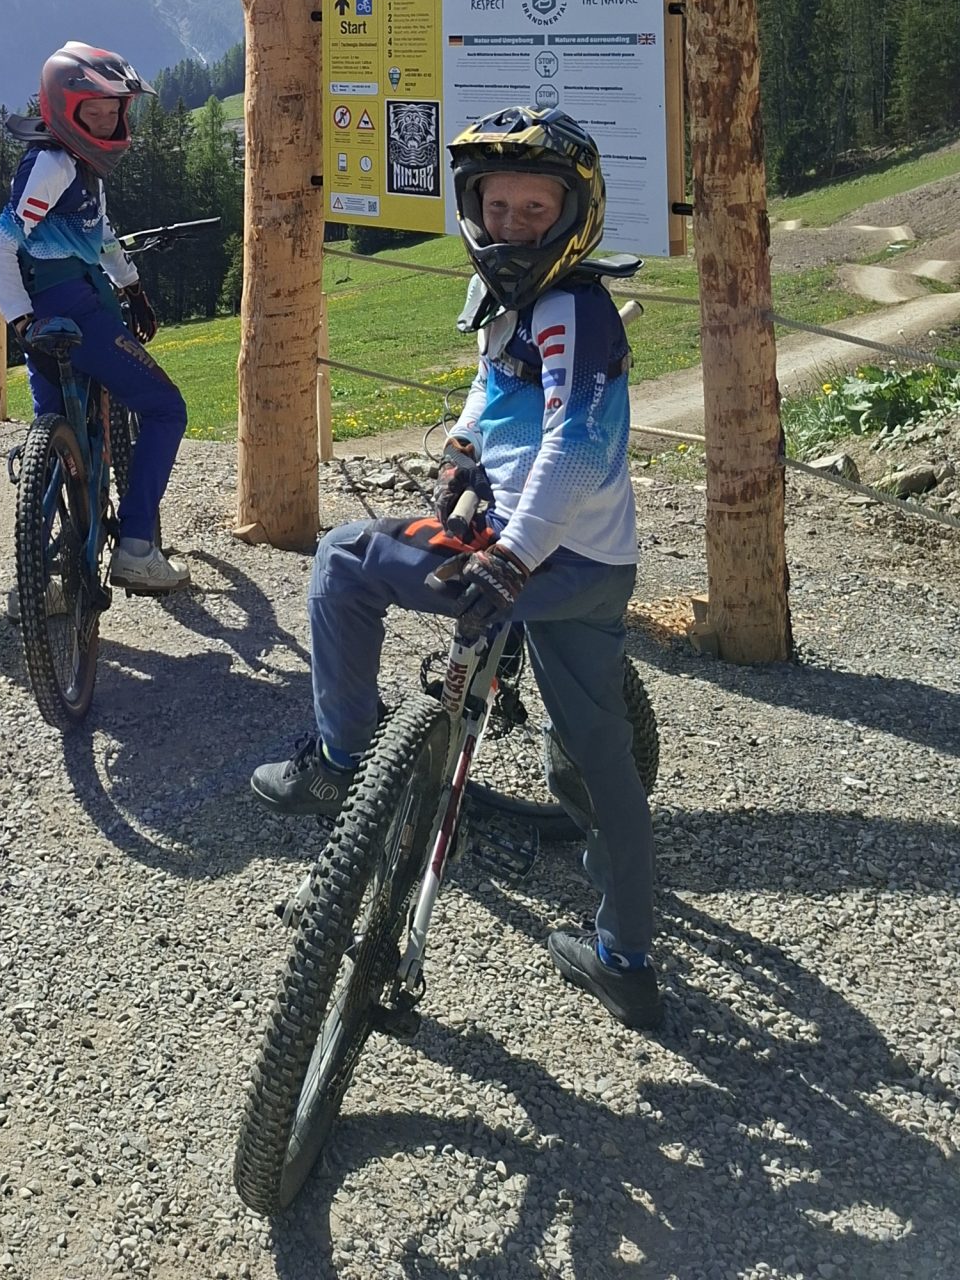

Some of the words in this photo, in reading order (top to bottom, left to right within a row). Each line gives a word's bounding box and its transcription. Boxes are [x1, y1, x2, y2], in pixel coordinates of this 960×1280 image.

[522, 2, 567, 26] BRANDNERTAL
[340, 20, 367, 35] Start
[590, 36, 630, 44] surrounding
[538, 57, 555, 65] STOP!
[538, 90, 555, 98] STOP!
[442, 658, 468, 713] CLASH
